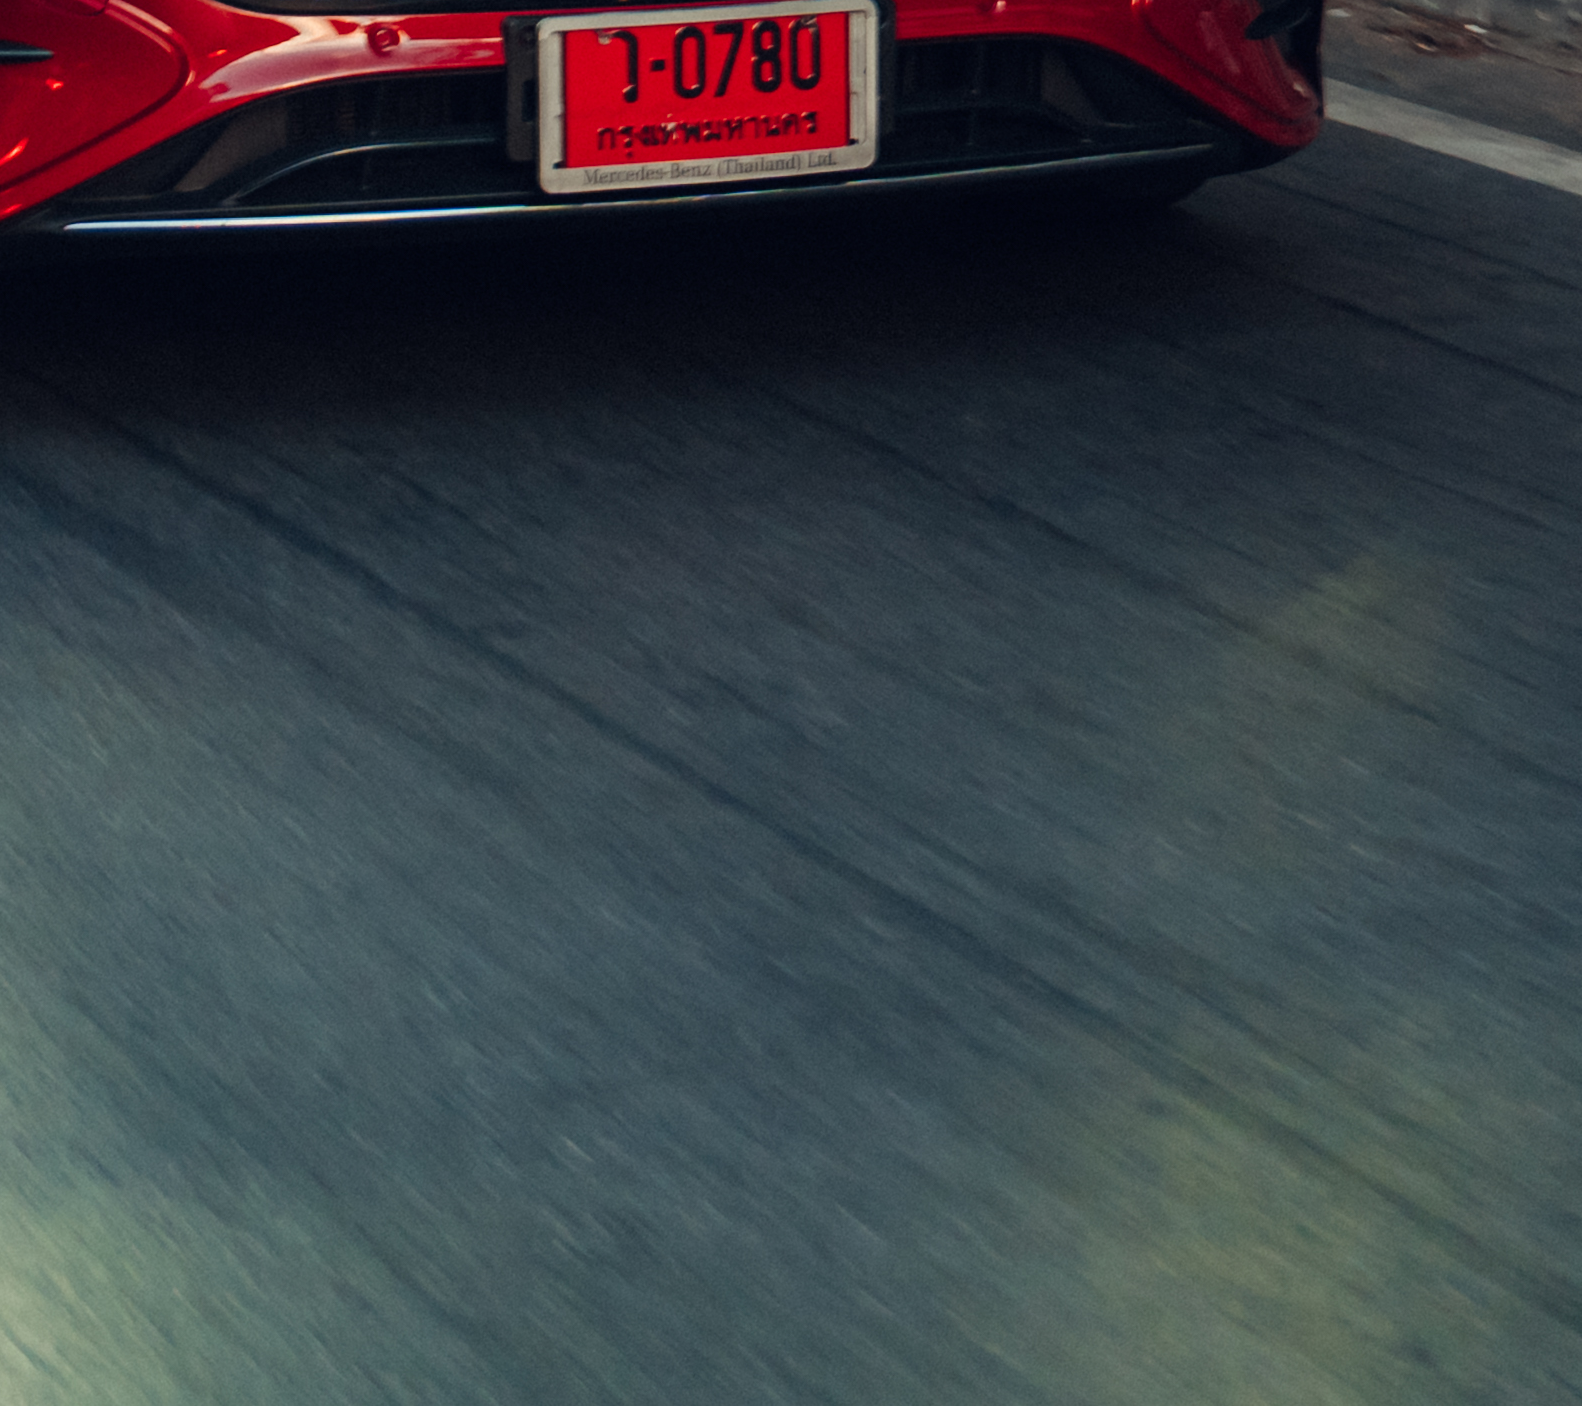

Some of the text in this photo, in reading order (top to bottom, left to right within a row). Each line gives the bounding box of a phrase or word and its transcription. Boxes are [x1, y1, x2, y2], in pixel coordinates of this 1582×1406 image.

[596, 109, 818, 159] กรุงเทพมหานคร
[583, 151, 838, 186] Mercedes-Benz (Thailand) Ltd.
